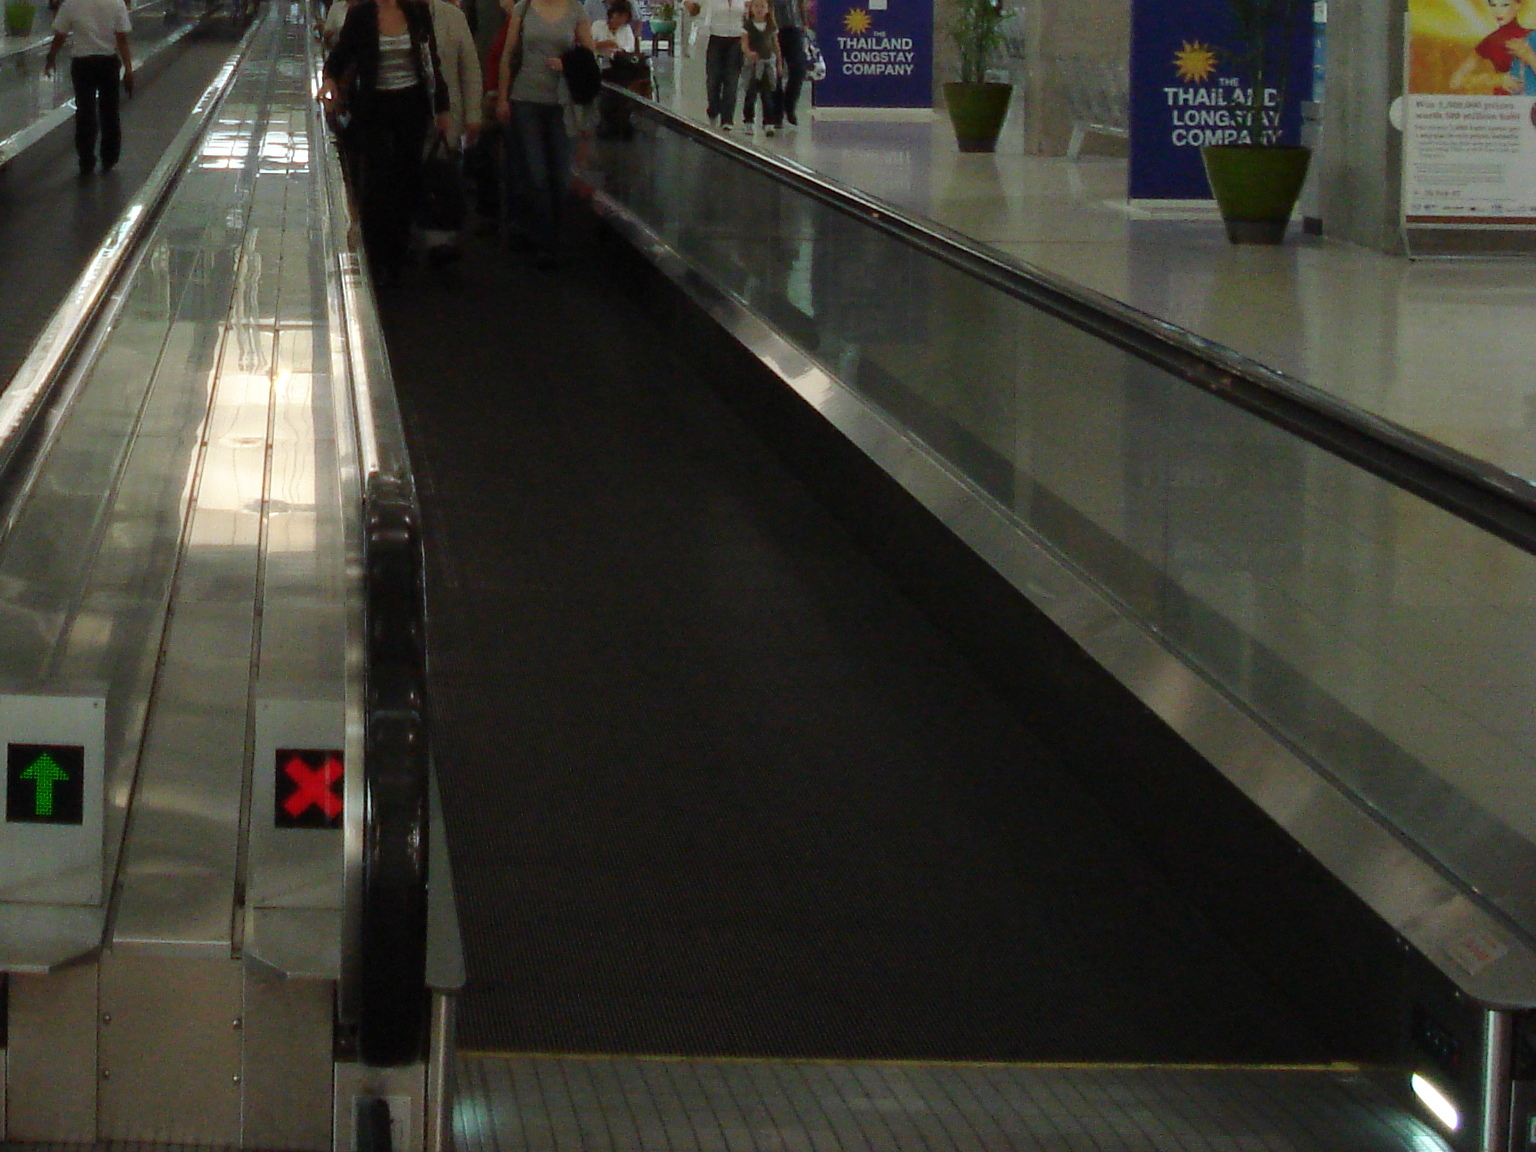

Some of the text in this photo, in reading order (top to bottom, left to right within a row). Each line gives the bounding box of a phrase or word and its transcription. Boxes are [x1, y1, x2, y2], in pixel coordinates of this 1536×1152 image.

[837, 38, 913, 50] THAILAND
[843, 51, 914, 62] LONGSTAY
[842, 64, 914, 75] COMPANY
[1219, 77, 1240, 86] THE
